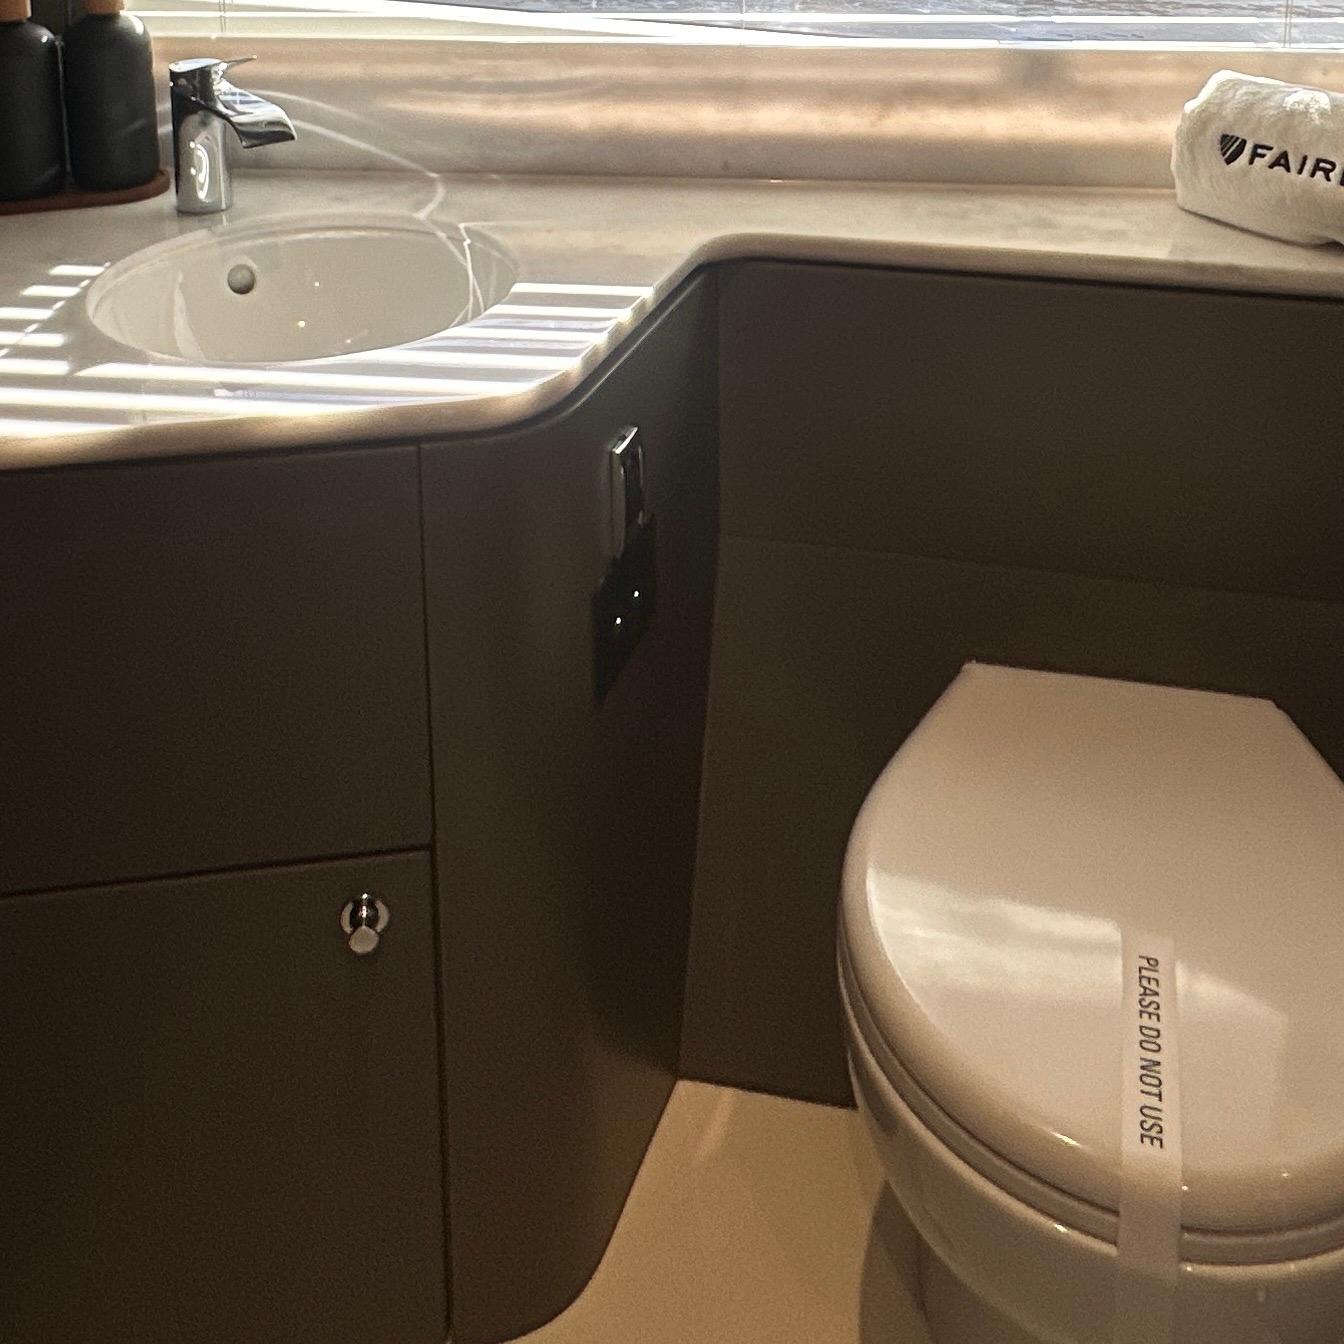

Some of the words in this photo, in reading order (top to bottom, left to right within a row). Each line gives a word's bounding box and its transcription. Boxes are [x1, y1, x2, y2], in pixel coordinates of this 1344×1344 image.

[1138, 955, 1161, 1022] PLEASE
[1139, 1024, 1162, 1053] DO
[1139, 1056, 1163, 1102] NOT
[1139, 1105, 1164, 1149] USE
